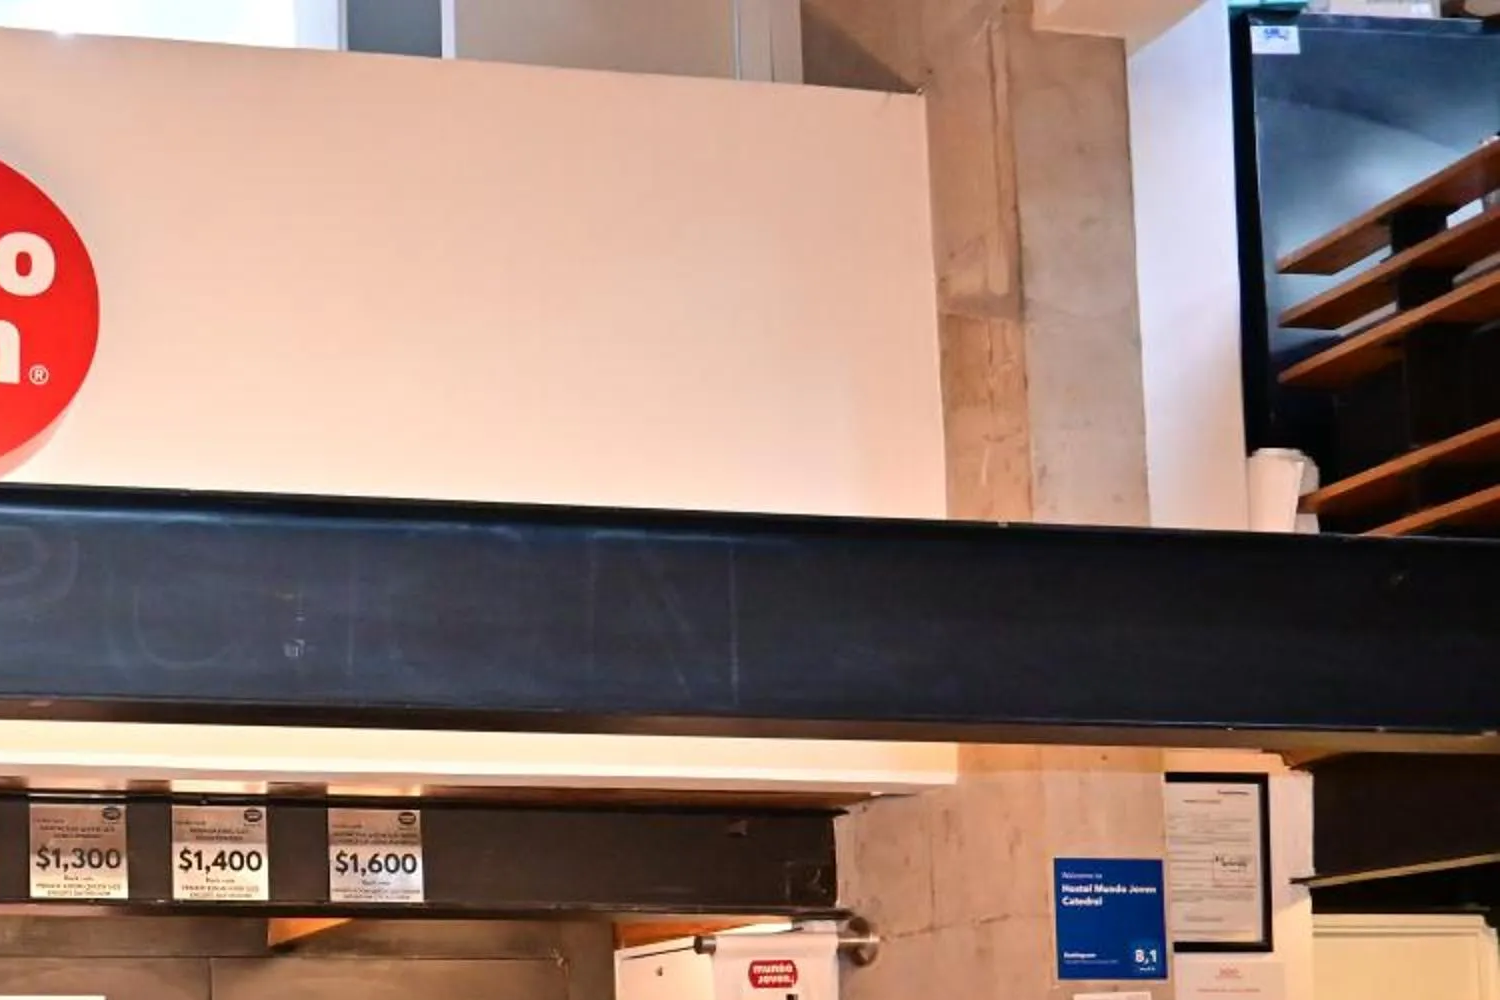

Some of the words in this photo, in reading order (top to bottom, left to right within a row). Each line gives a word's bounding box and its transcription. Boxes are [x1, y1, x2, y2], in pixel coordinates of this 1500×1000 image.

[36, 844, 121, 872] $1,300
[179, 848, 263, 874] $1,400
[336, 850, 417, 877] $1,600
